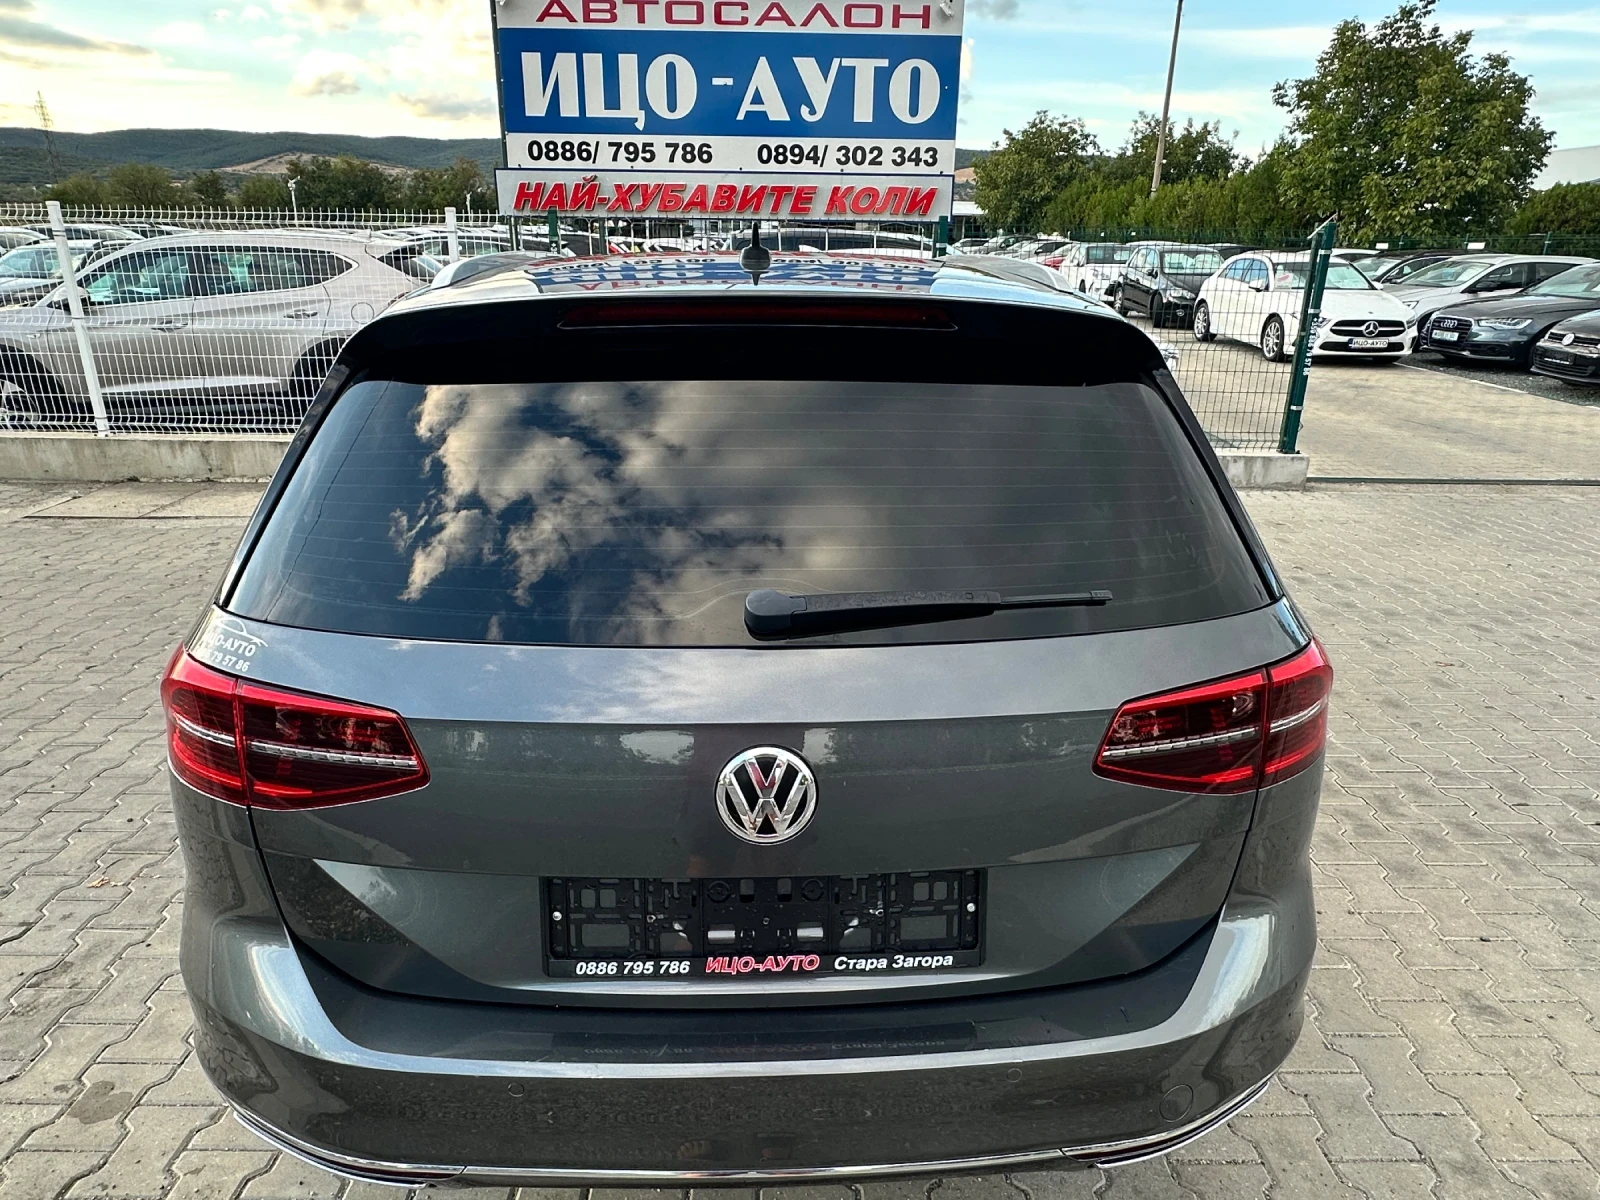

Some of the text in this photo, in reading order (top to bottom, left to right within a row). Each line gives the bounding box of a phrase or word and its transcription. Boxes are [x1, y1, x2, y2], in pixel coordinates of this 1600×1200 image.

[535, 0, 931, 30] АВТОСАЛОН
[527, 140, 713, 164] 0886/ 795 786
[757, 144, 938, 168] 0894/ 302 343
[513, 174, 939, 216] НАЙ-ХУБАВИТЕ КОЛИ
[212, 651, 224, 663] 79
[222, 655, 237, 667] 57
[235, 660, 250, 672] 86
[575, 954, 954, 975] 0886 795 786 ИЦО-АУТО Стара Загора
